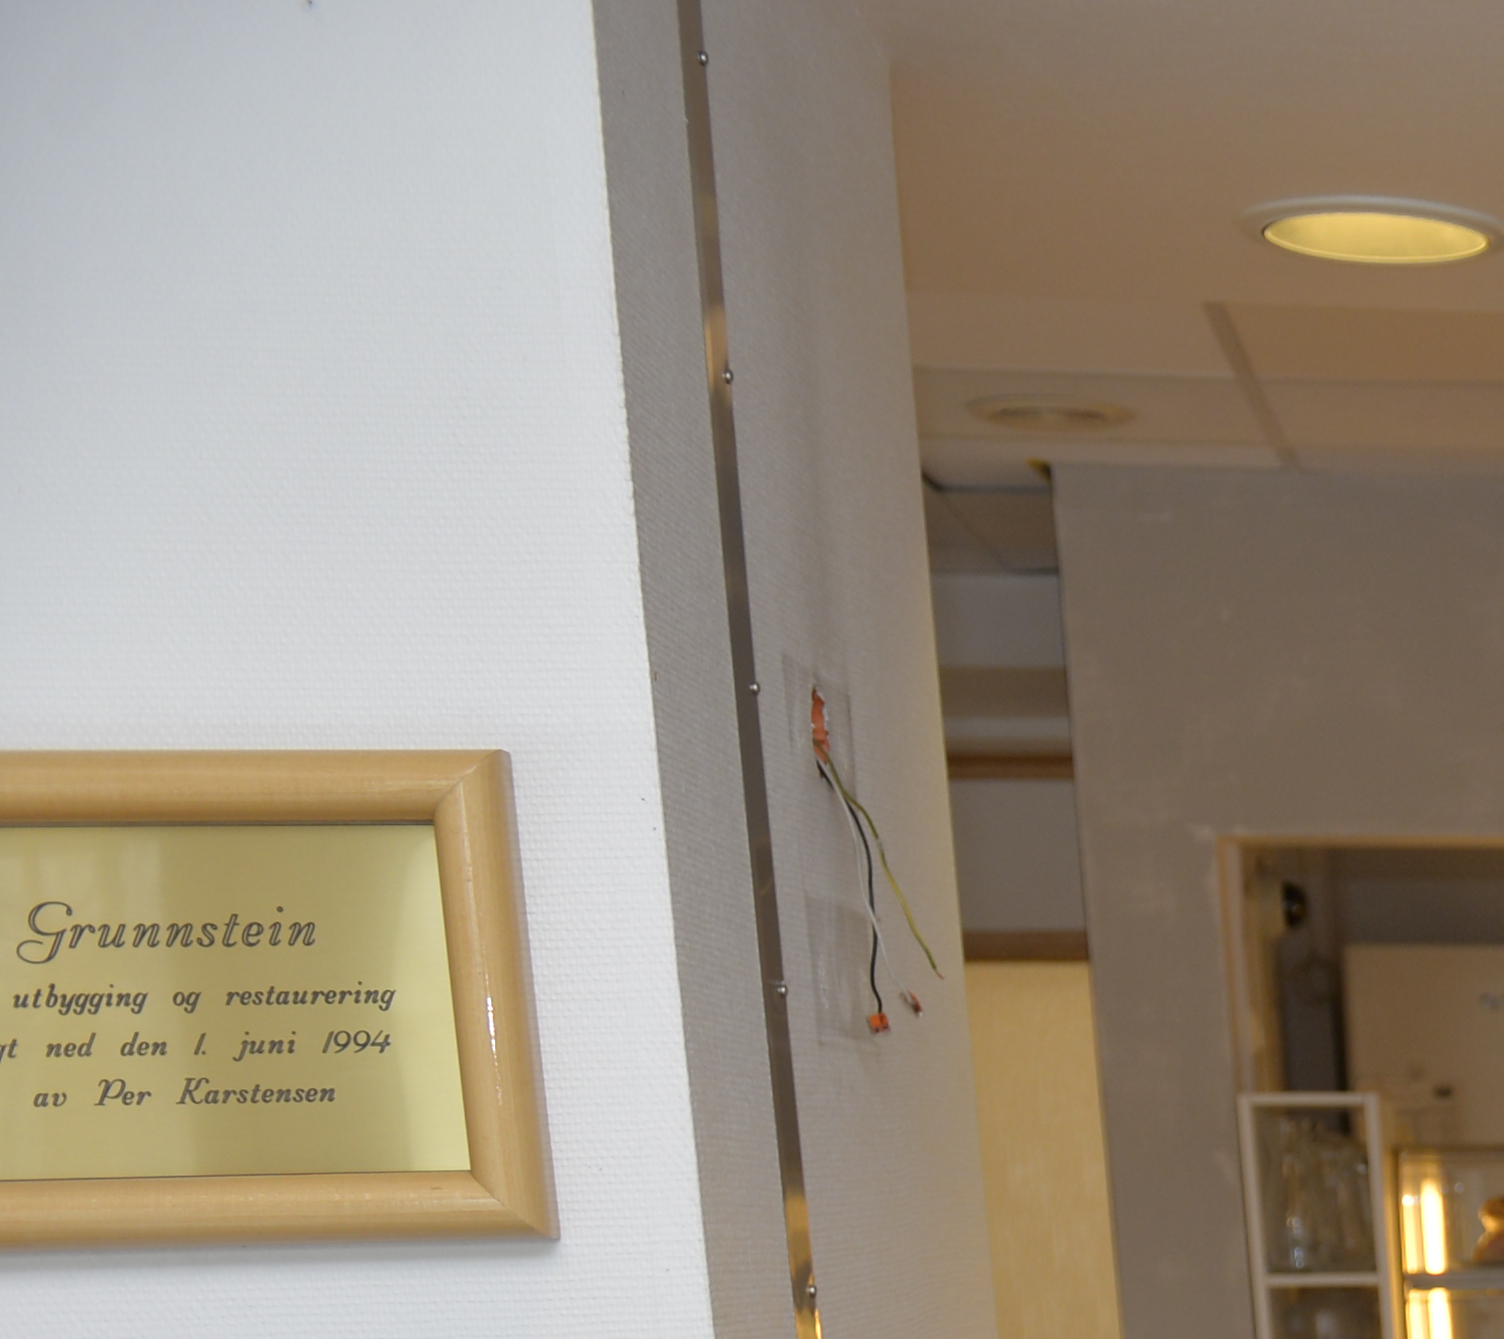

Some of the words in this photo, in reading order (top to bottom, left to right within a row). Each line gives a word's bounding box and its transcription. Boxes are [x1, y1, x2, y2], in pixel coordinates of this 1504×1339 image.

[16, 901, 316, 964] Grunnstein
[12, 983, 148, 1015] utbygging
[172, 991, 201, 1014] og
[225, 981, 396, 1011] restaurering
[46, 1032, 96, 1058] ned
[120, 1031, 167, 1056] den
[193, 1032, 207, 1056] 1.
[232, 1031, 296, 1062] juni
[321, 1029, 391, 1054] 1994
[33, 1092, 67, 1107] av
[94, 1078, 152, 1106] Per
[176, 1077, 336, 1105] Karstensen
